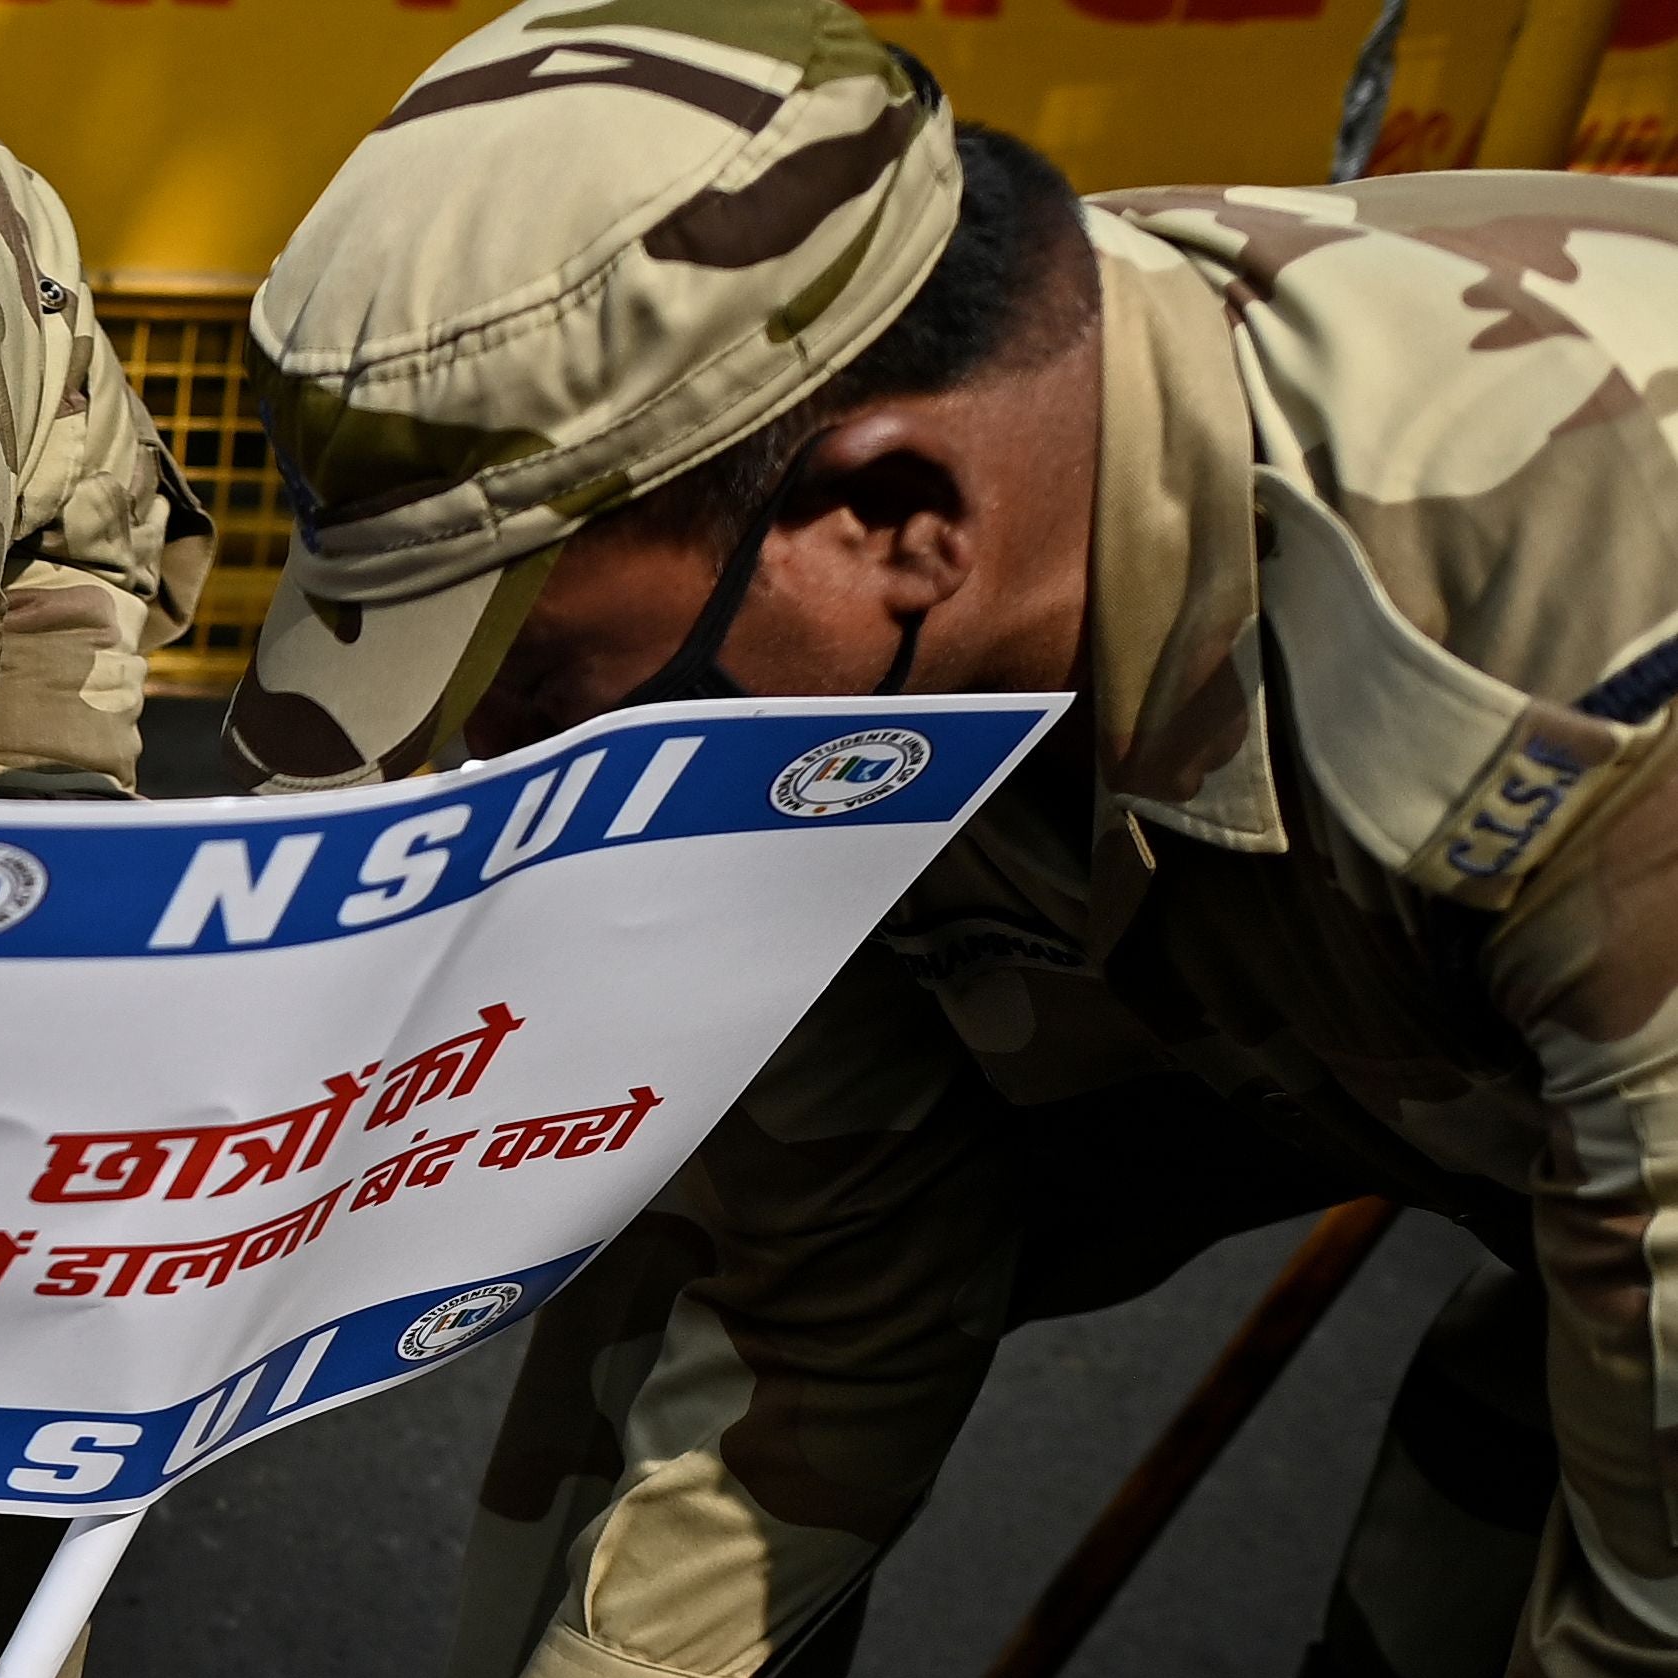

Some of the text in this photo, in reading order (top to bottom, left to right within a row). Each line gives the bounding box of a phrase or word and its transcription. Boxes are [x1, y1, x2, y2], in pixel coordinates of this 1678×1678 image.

[153, 737, 703, 947] NSUI
[31, 1003, 526, 1204] छात्रों को
[36, 1183, 354, 1297] डालना
[348, 1129, 481, 1212] बंद
[477, 1086, 665, 1171] करो
